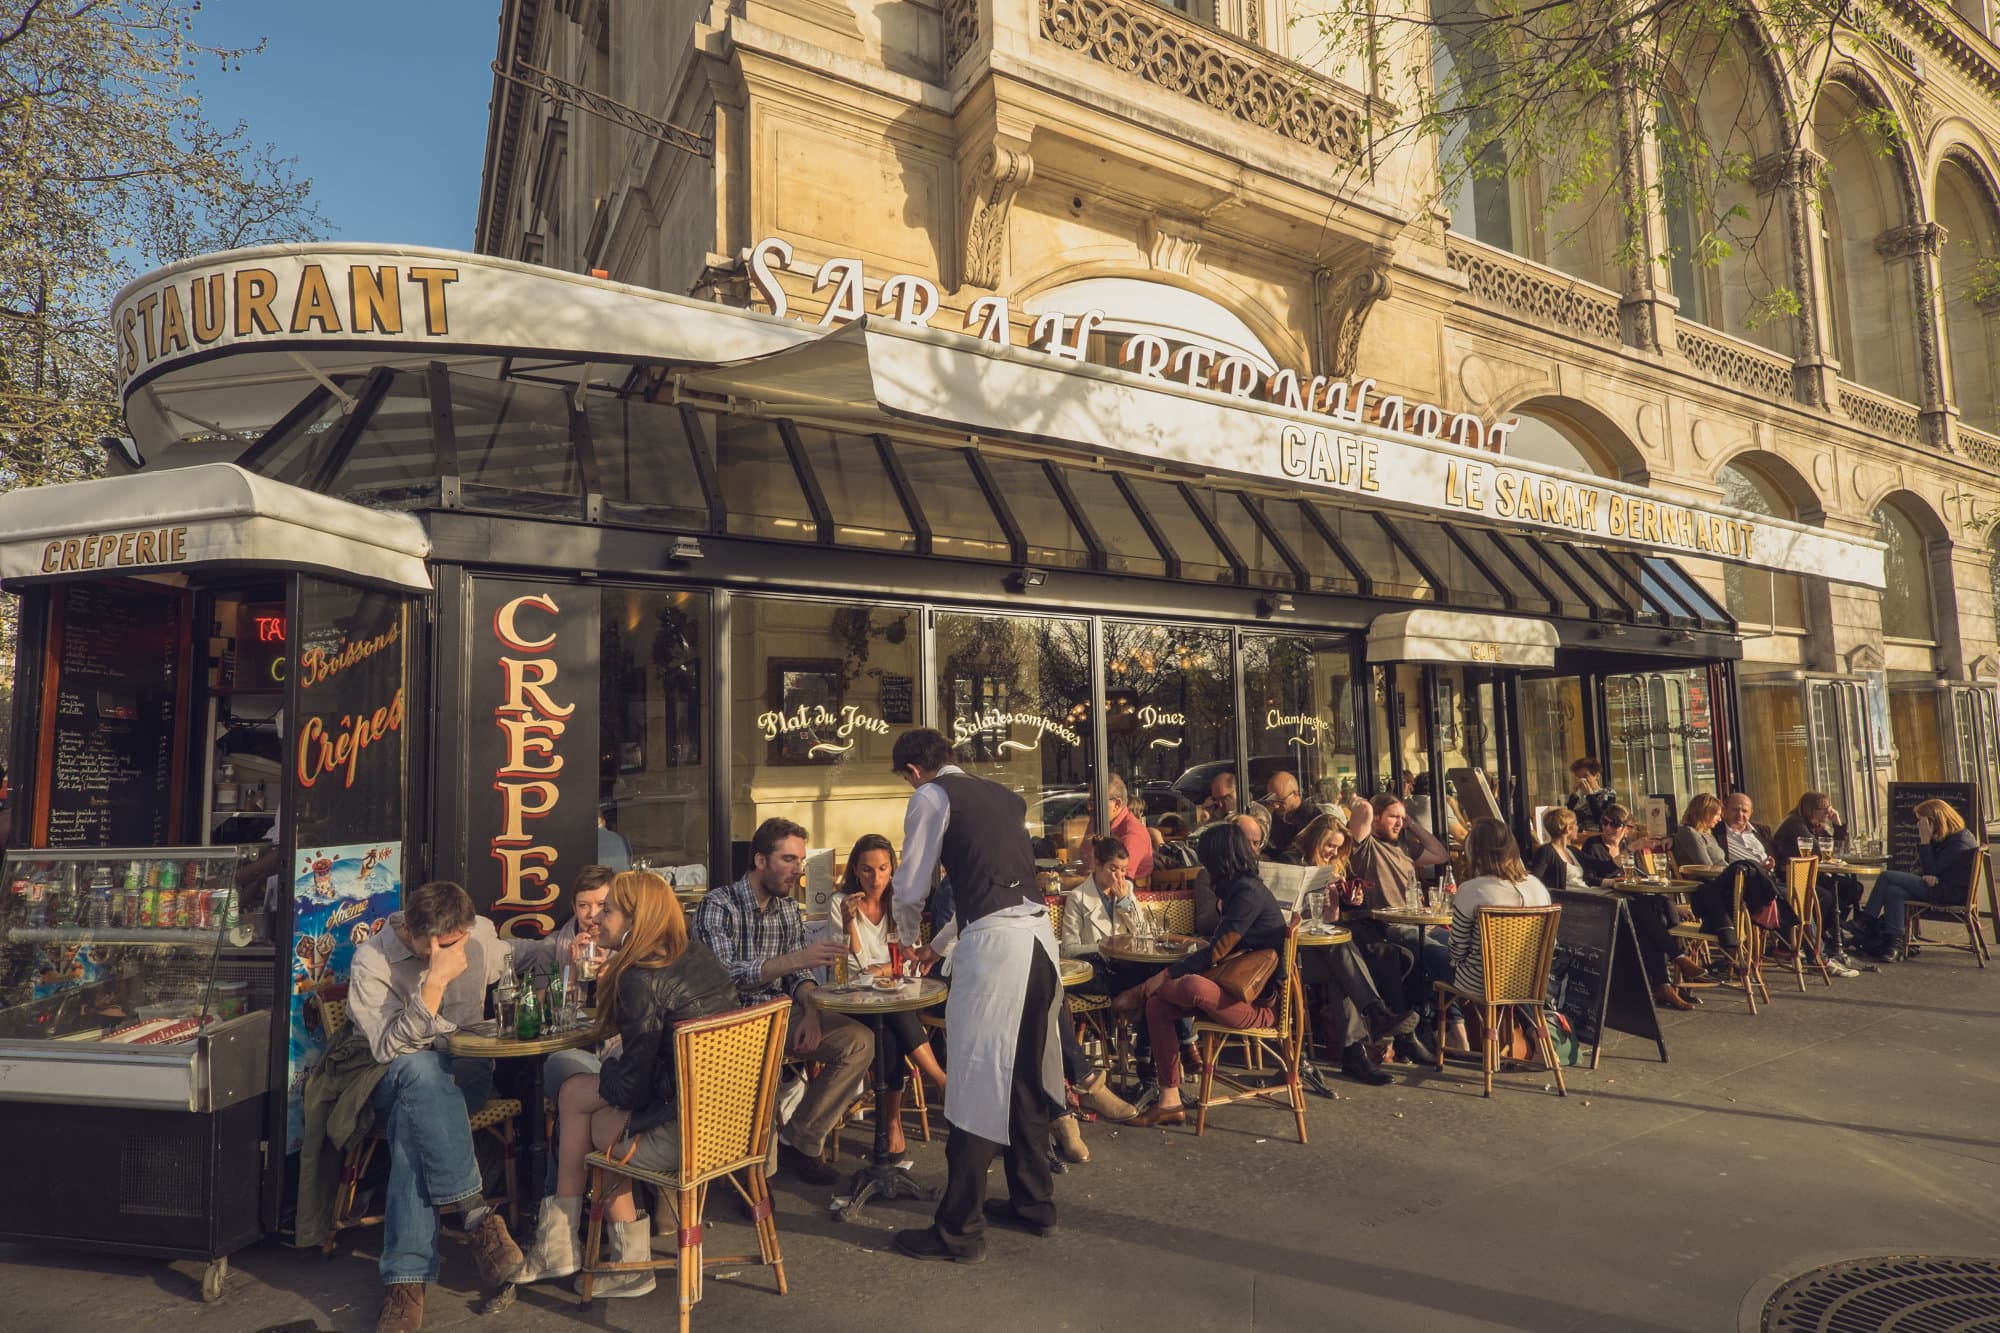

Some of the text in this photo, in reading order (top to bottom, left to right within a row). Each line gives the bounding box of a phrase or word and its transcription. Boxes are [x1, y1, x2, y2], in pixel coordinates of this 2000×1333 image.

[117, 264, 458, 387] ESTAURANT
[749, 237, 1105, 361] SARAH
[1281, 424, 1379, 491] CAFE
[1446, 459, 1754, 559] LE SARAH BERNHARDT
[301, 621, 400, 688] Boissons
[298, 687, 405, 789] Crêpes
[757, 704, 890, 741] Plat du Jour
[951, 708, 1081, 749] Salades composées
[1137, 704, 1186, 728] Diner
[1265, 709, 1329, 734] Champagne
